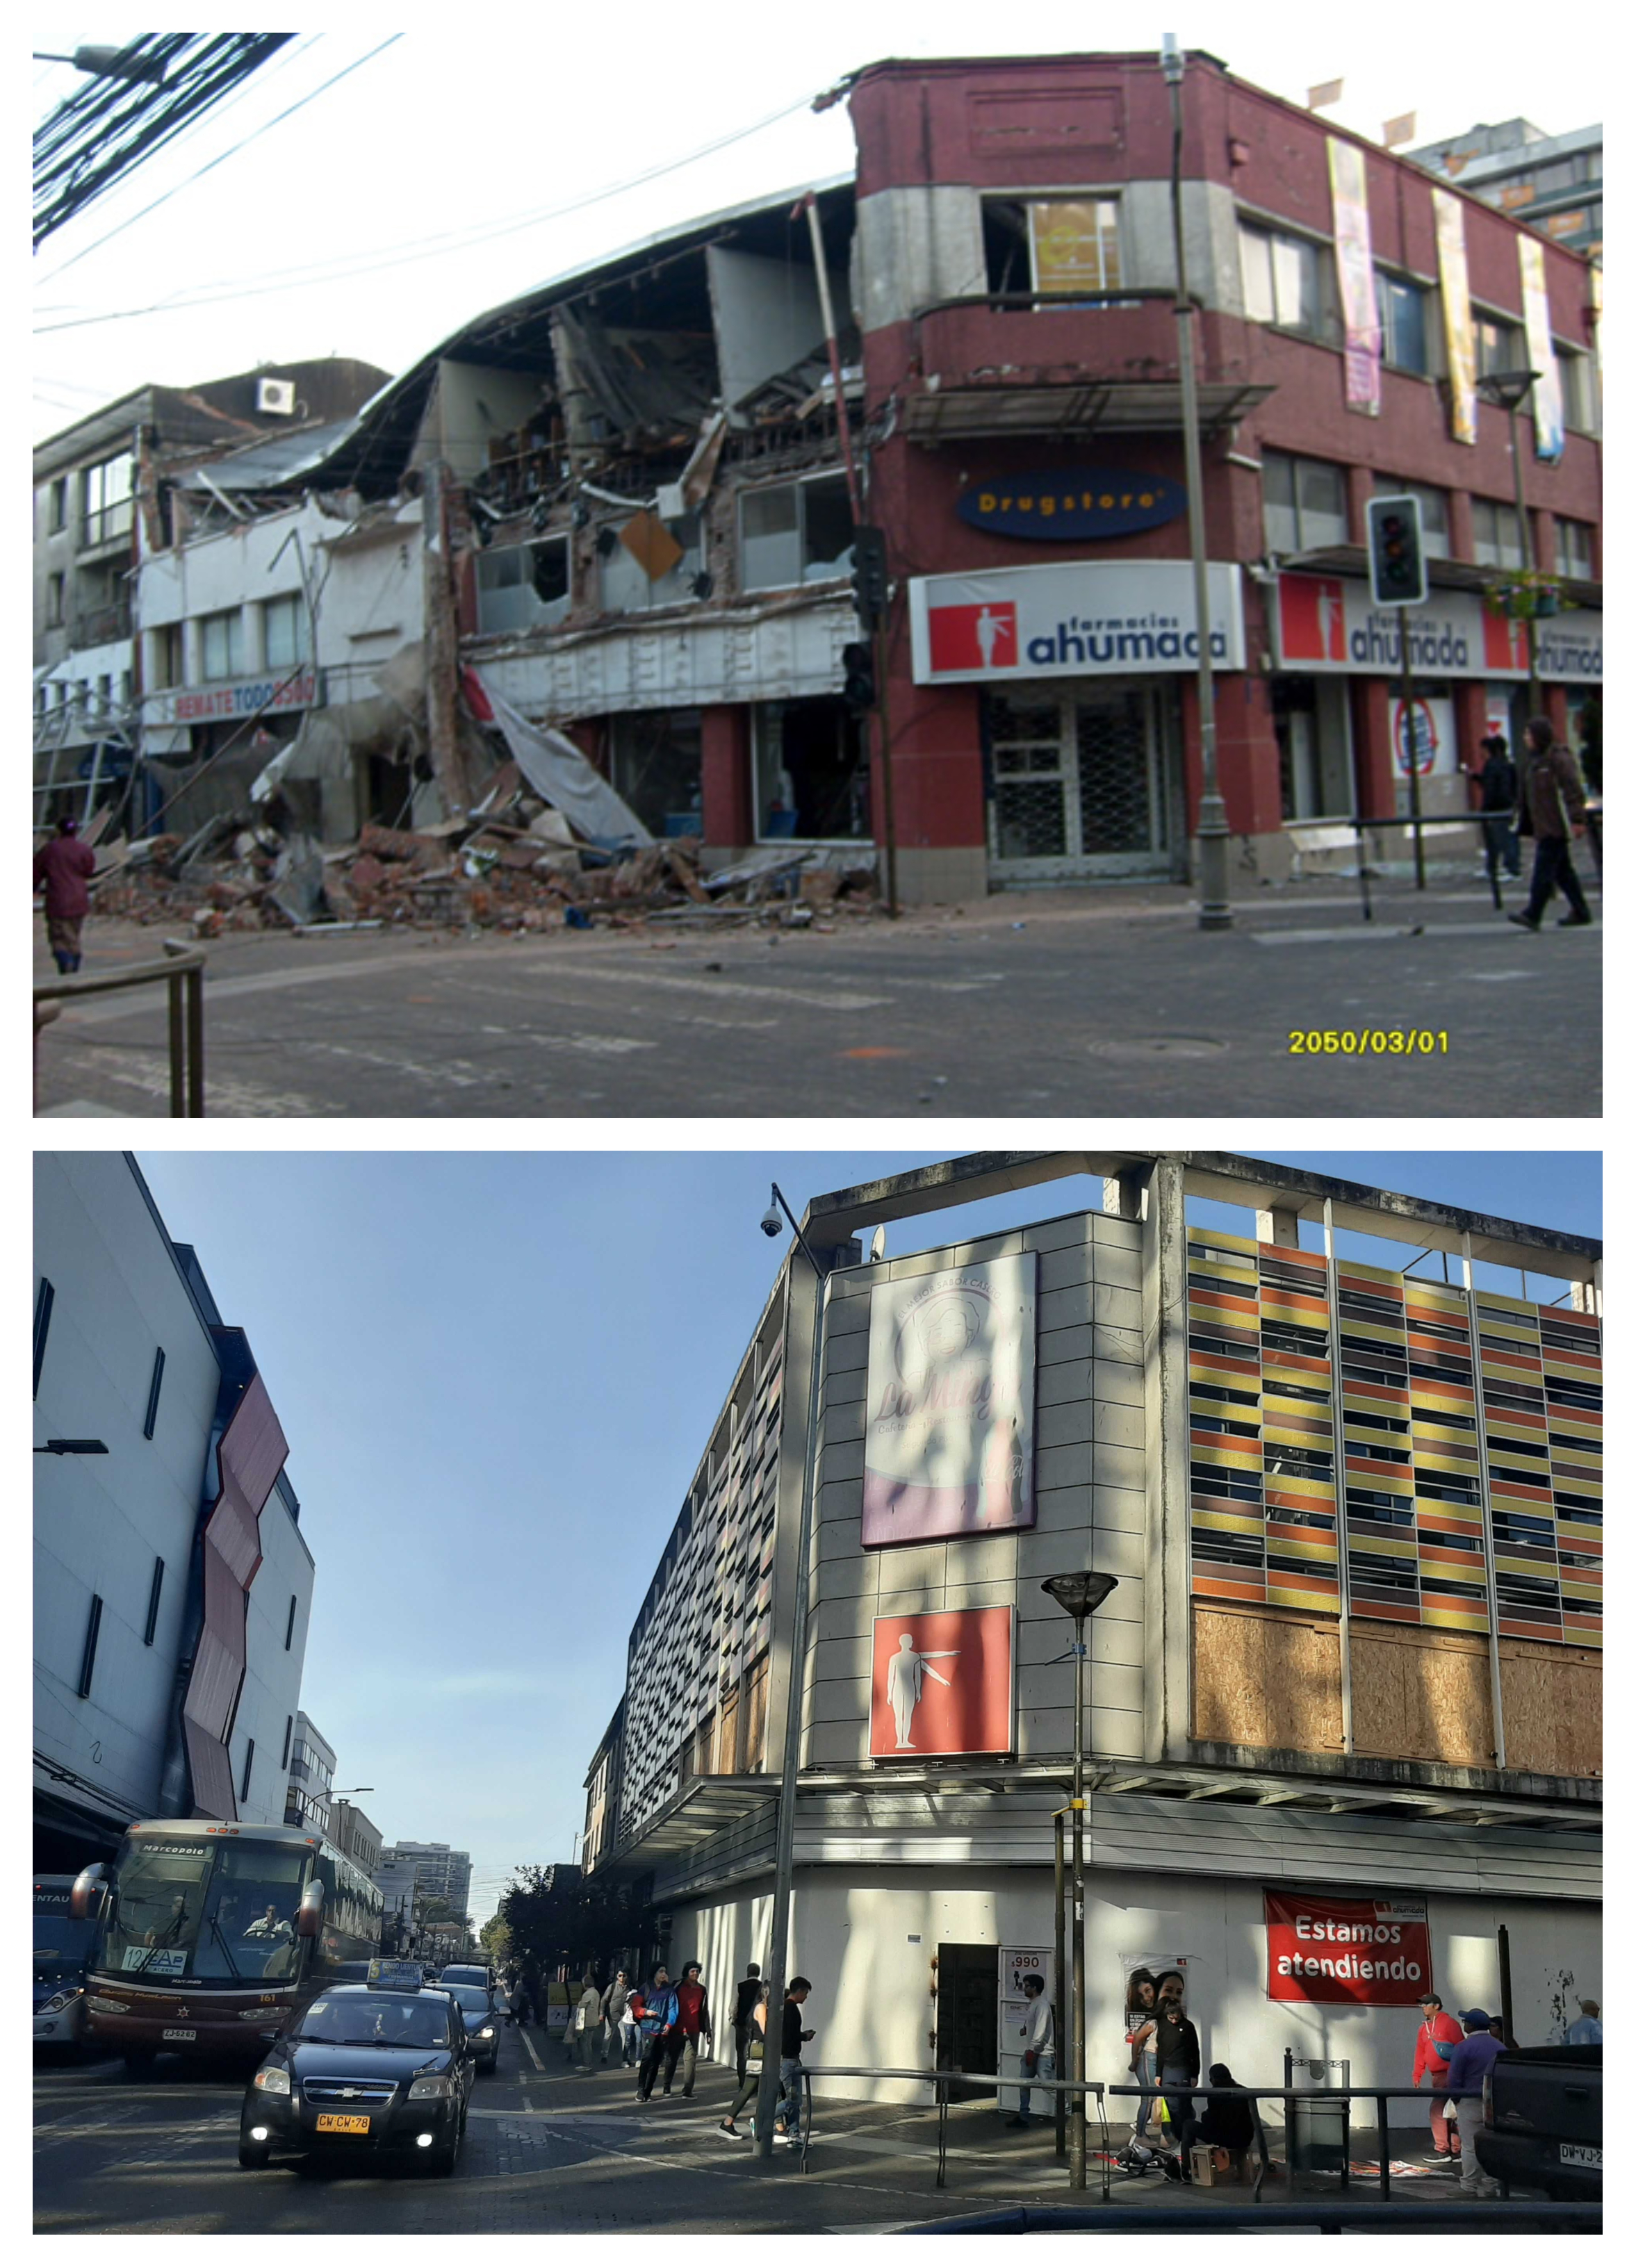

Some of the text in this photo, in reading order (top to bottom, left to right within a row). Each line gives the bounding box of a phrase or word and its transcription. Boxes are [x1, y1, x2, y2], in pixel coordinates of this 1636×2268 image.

[979, 493, 1154, 516] Drugstore
[1069, 614, 1178, 632] farmacias
[898, 1278, 1001, 1319] EL MEJOR SABOR CASERO
[874, 1382, 917, 1422] La
[144, 1845, 204, 1855] Marcopolo
[1295, 1915, 1401, 1944] Estamos
[1011, 1957, 1040, 1968] $990
[1277, 1953, 1421, 1981] atendiendo
